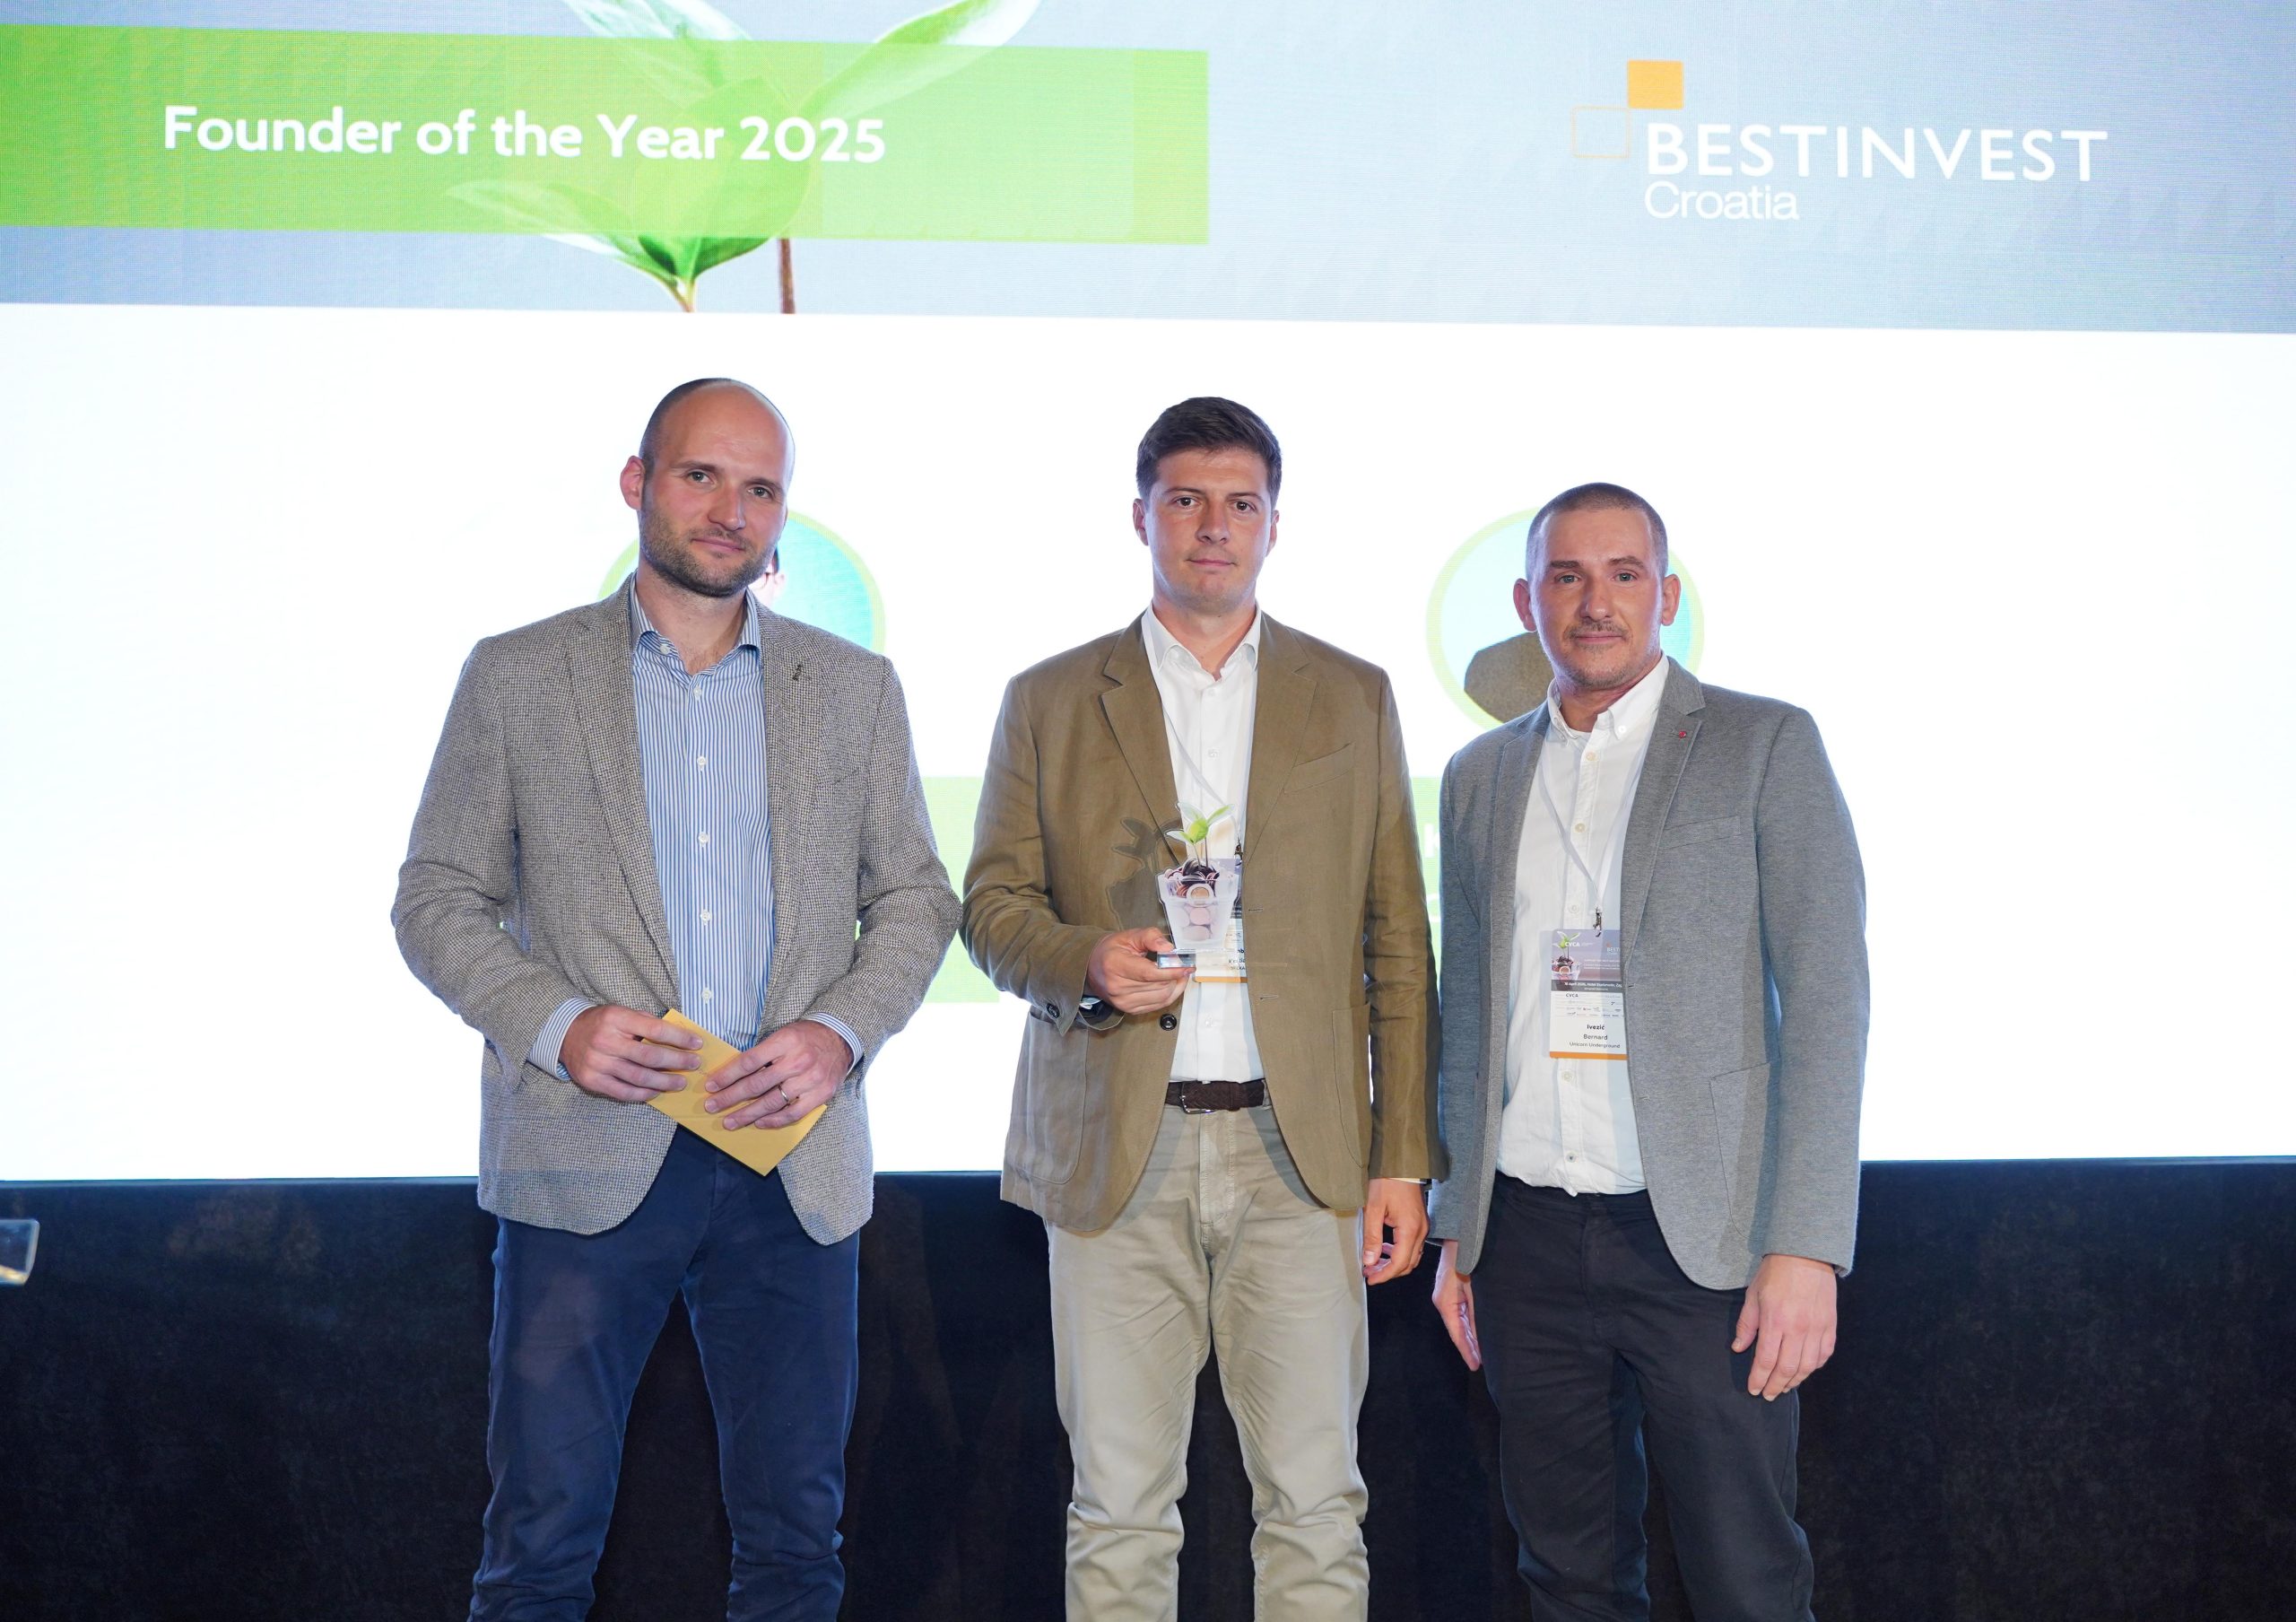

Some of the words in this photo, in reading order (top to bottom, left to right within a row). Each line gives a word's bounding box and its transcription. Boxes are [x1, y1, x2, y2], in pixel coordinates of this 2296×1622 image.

[165, 105, 402, 153] Founder
[416, 109, 476, 154] of
[491, 110, 583, 157] the
[597, 114, 725, 160] Year
[741, 116, 885, 163] 2025
[1647, 122, 2109, 182] BESTINVEST
[1643, 180, 1800, 221] Croatia
